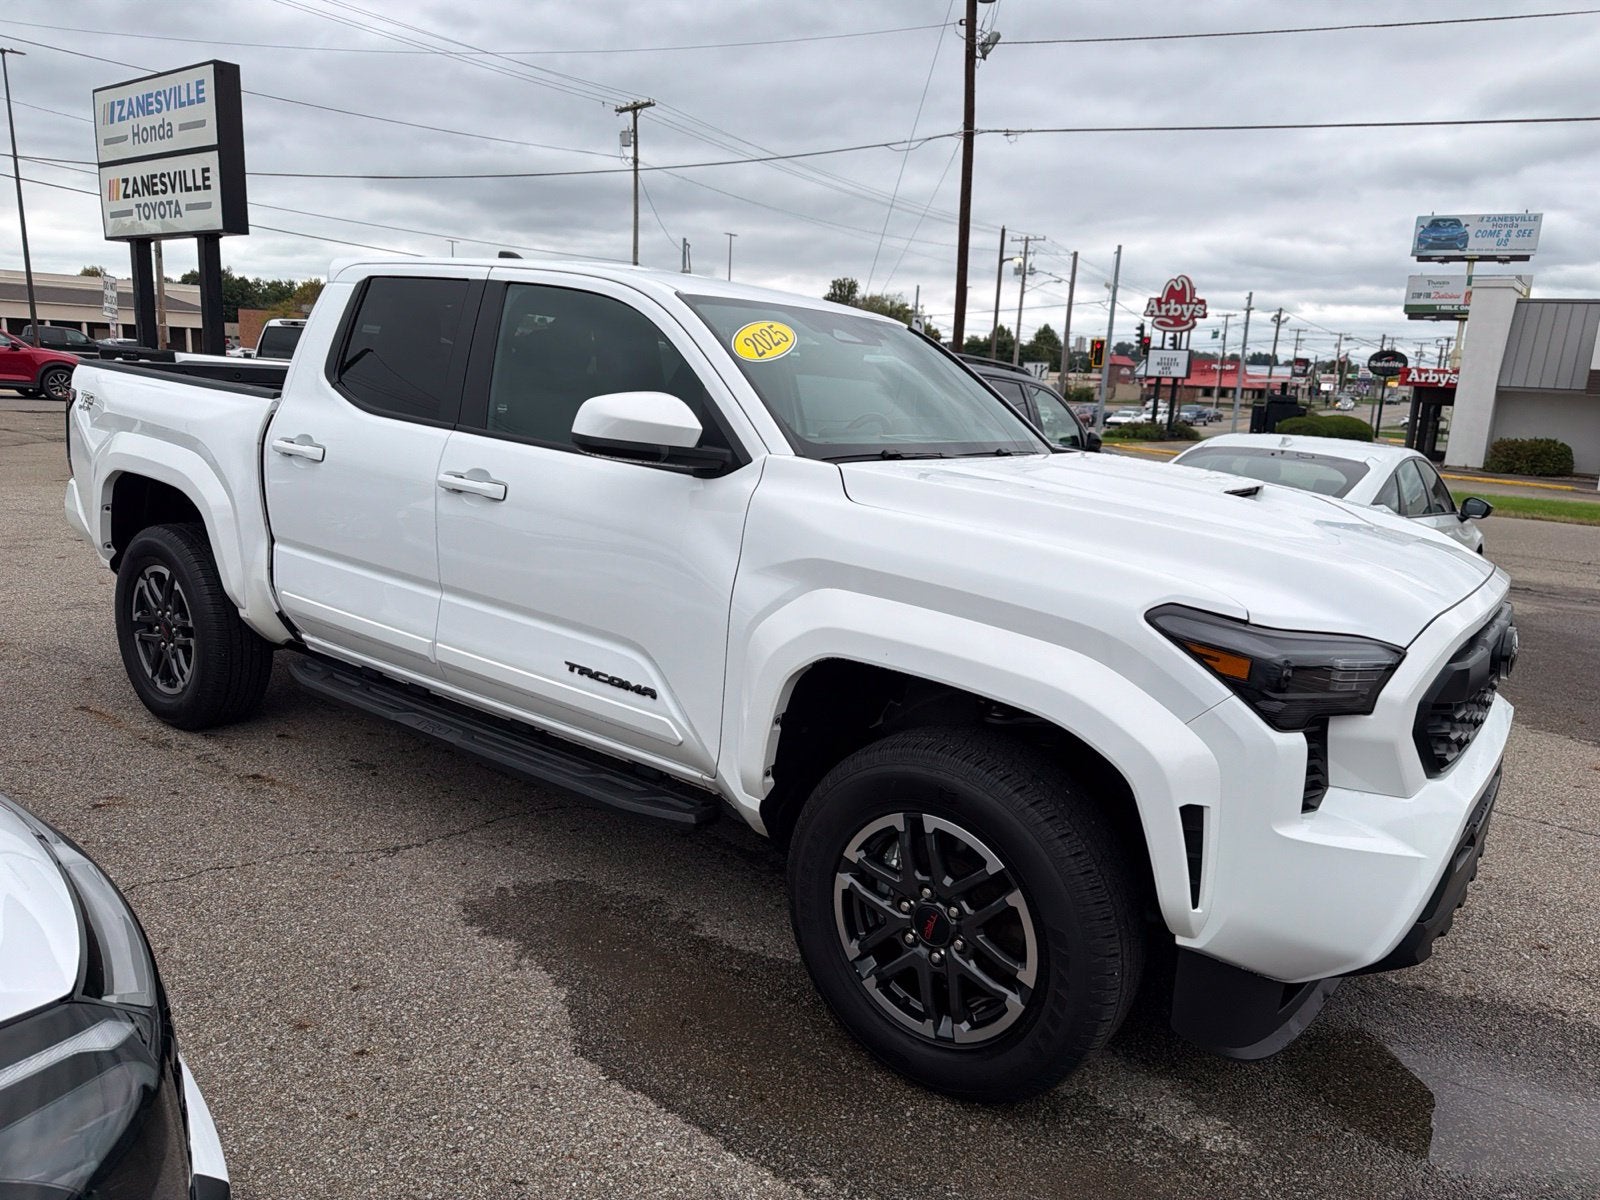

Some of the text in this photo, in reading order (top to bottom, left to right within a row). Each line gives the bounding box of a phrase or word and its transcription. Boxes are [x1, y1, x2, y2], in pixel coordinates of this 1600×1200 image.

[116, 79, 206, 122] ZANESVILLE
[131, 117, 173, 145] Honda
[121, 167, 212, 199] ZANESVILLE
[135, 199, 183, 221] TOYOTA
[1485, 215, 1538, 223] ZANESVILLE
[1474, 229, 1534, 238] COME & SEE
[1496, 238, 1510, 247] US
[1145, 298, 1205, 321] Arby's
[743, 324, 789, 357] 2025
[1406, 368, 1459, 387] Arby's
[564, 660, 657, 700] TACOMA
